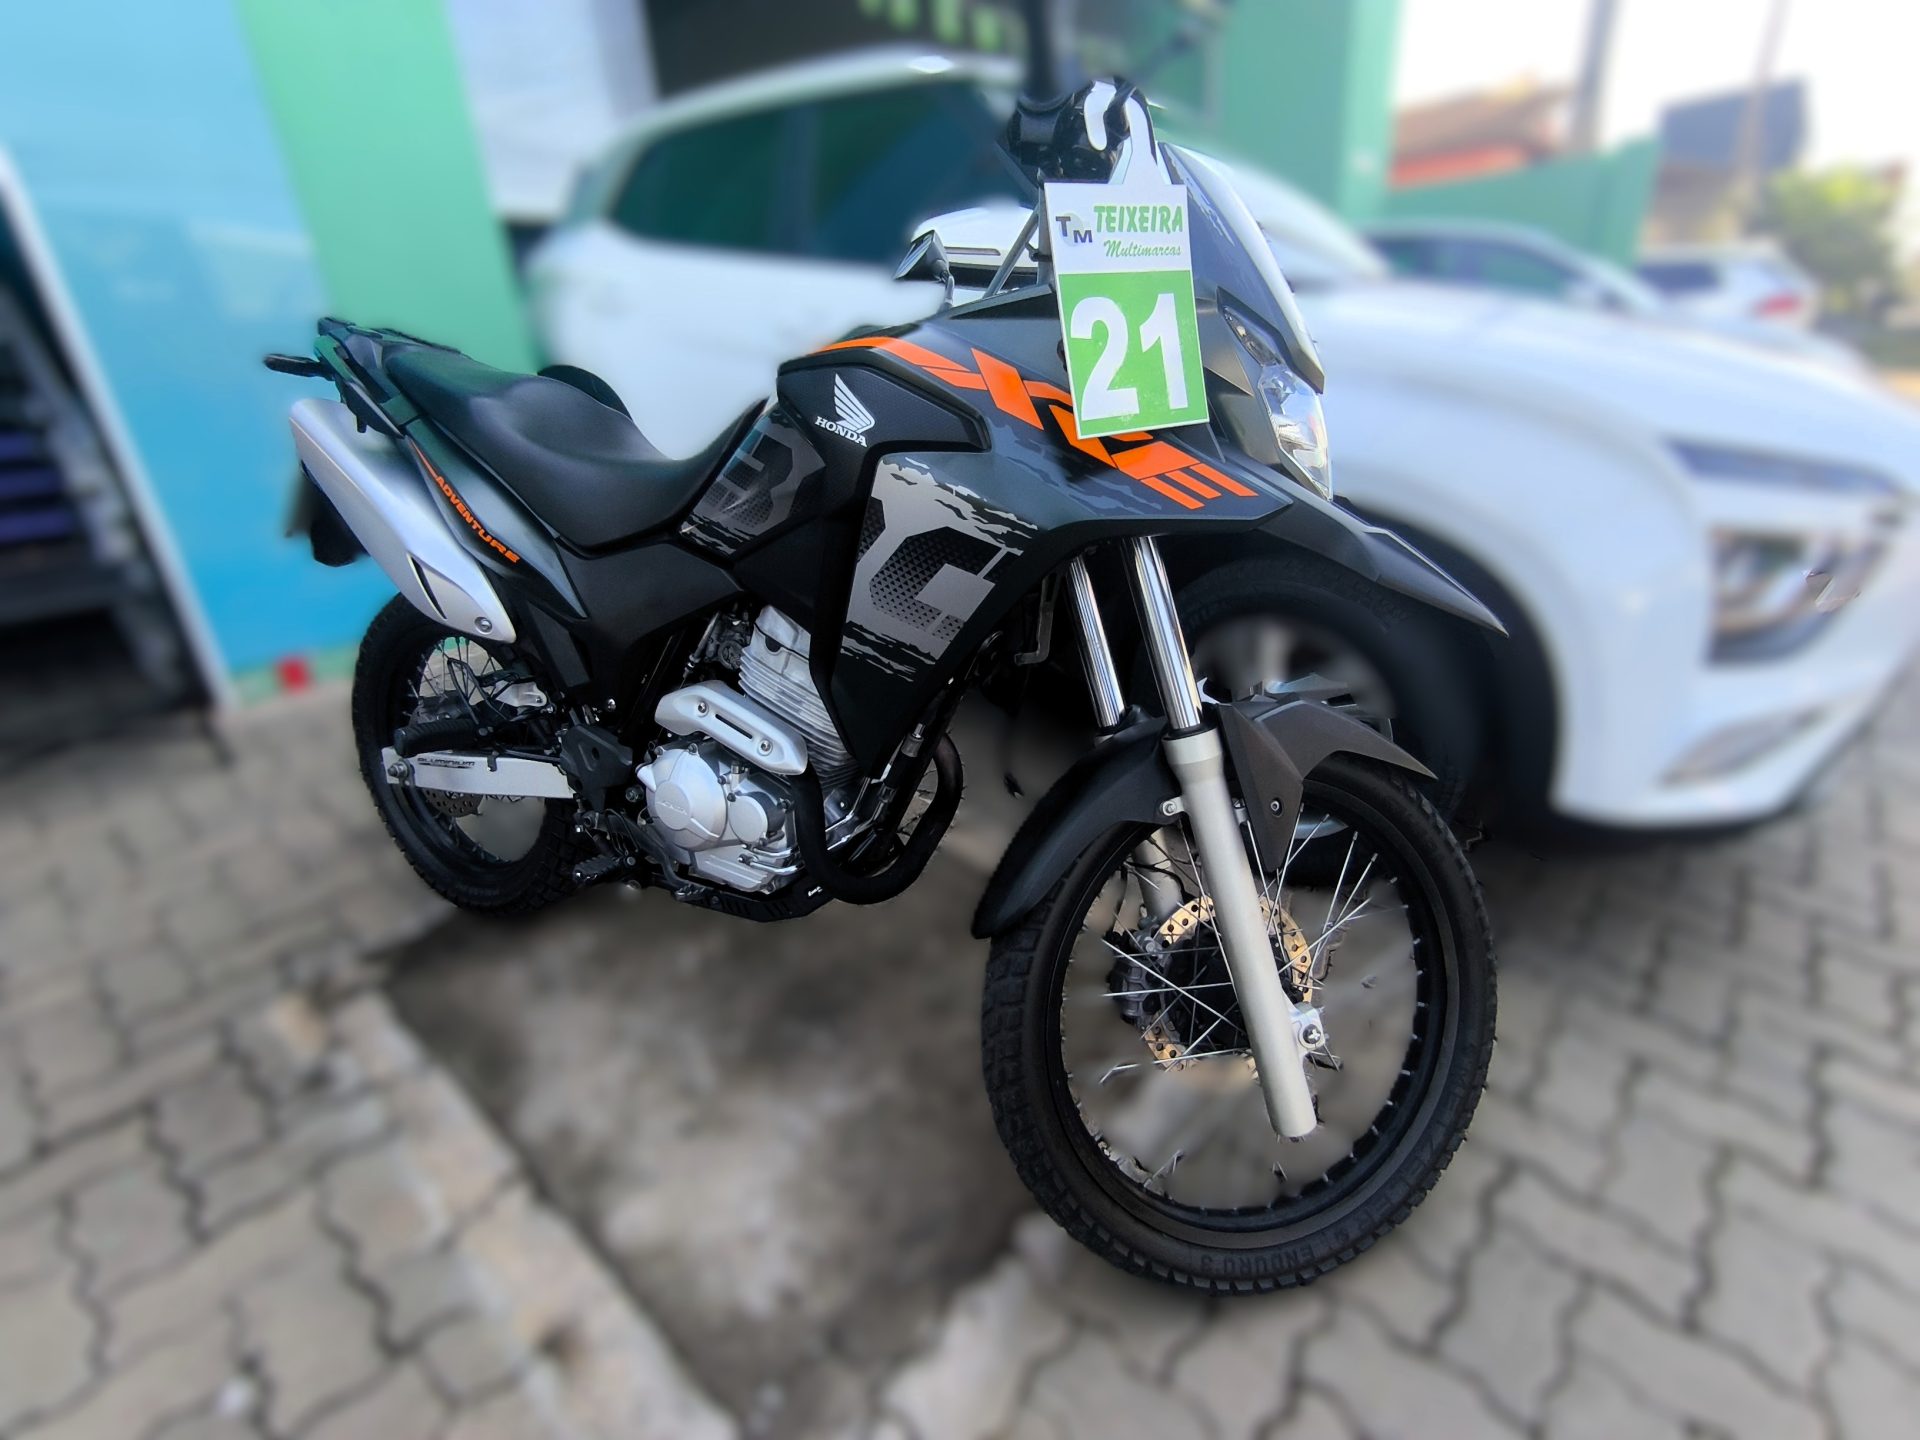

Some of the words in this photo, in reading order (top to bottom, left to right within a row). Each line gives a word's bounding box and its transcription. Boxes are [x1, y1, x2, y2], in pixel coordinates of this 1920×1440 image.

[1093, 205, 1184, 234] TEIXEIRA
[1103, 239, 1183, 258] Multimarcas
[1070, 292, 1189, 422] 21
[814, 416, 868, 448] HONDA
[436, 476, 521, 563] ADVENTURE
[1223, 1247, 1316, 1275] ENDURO
